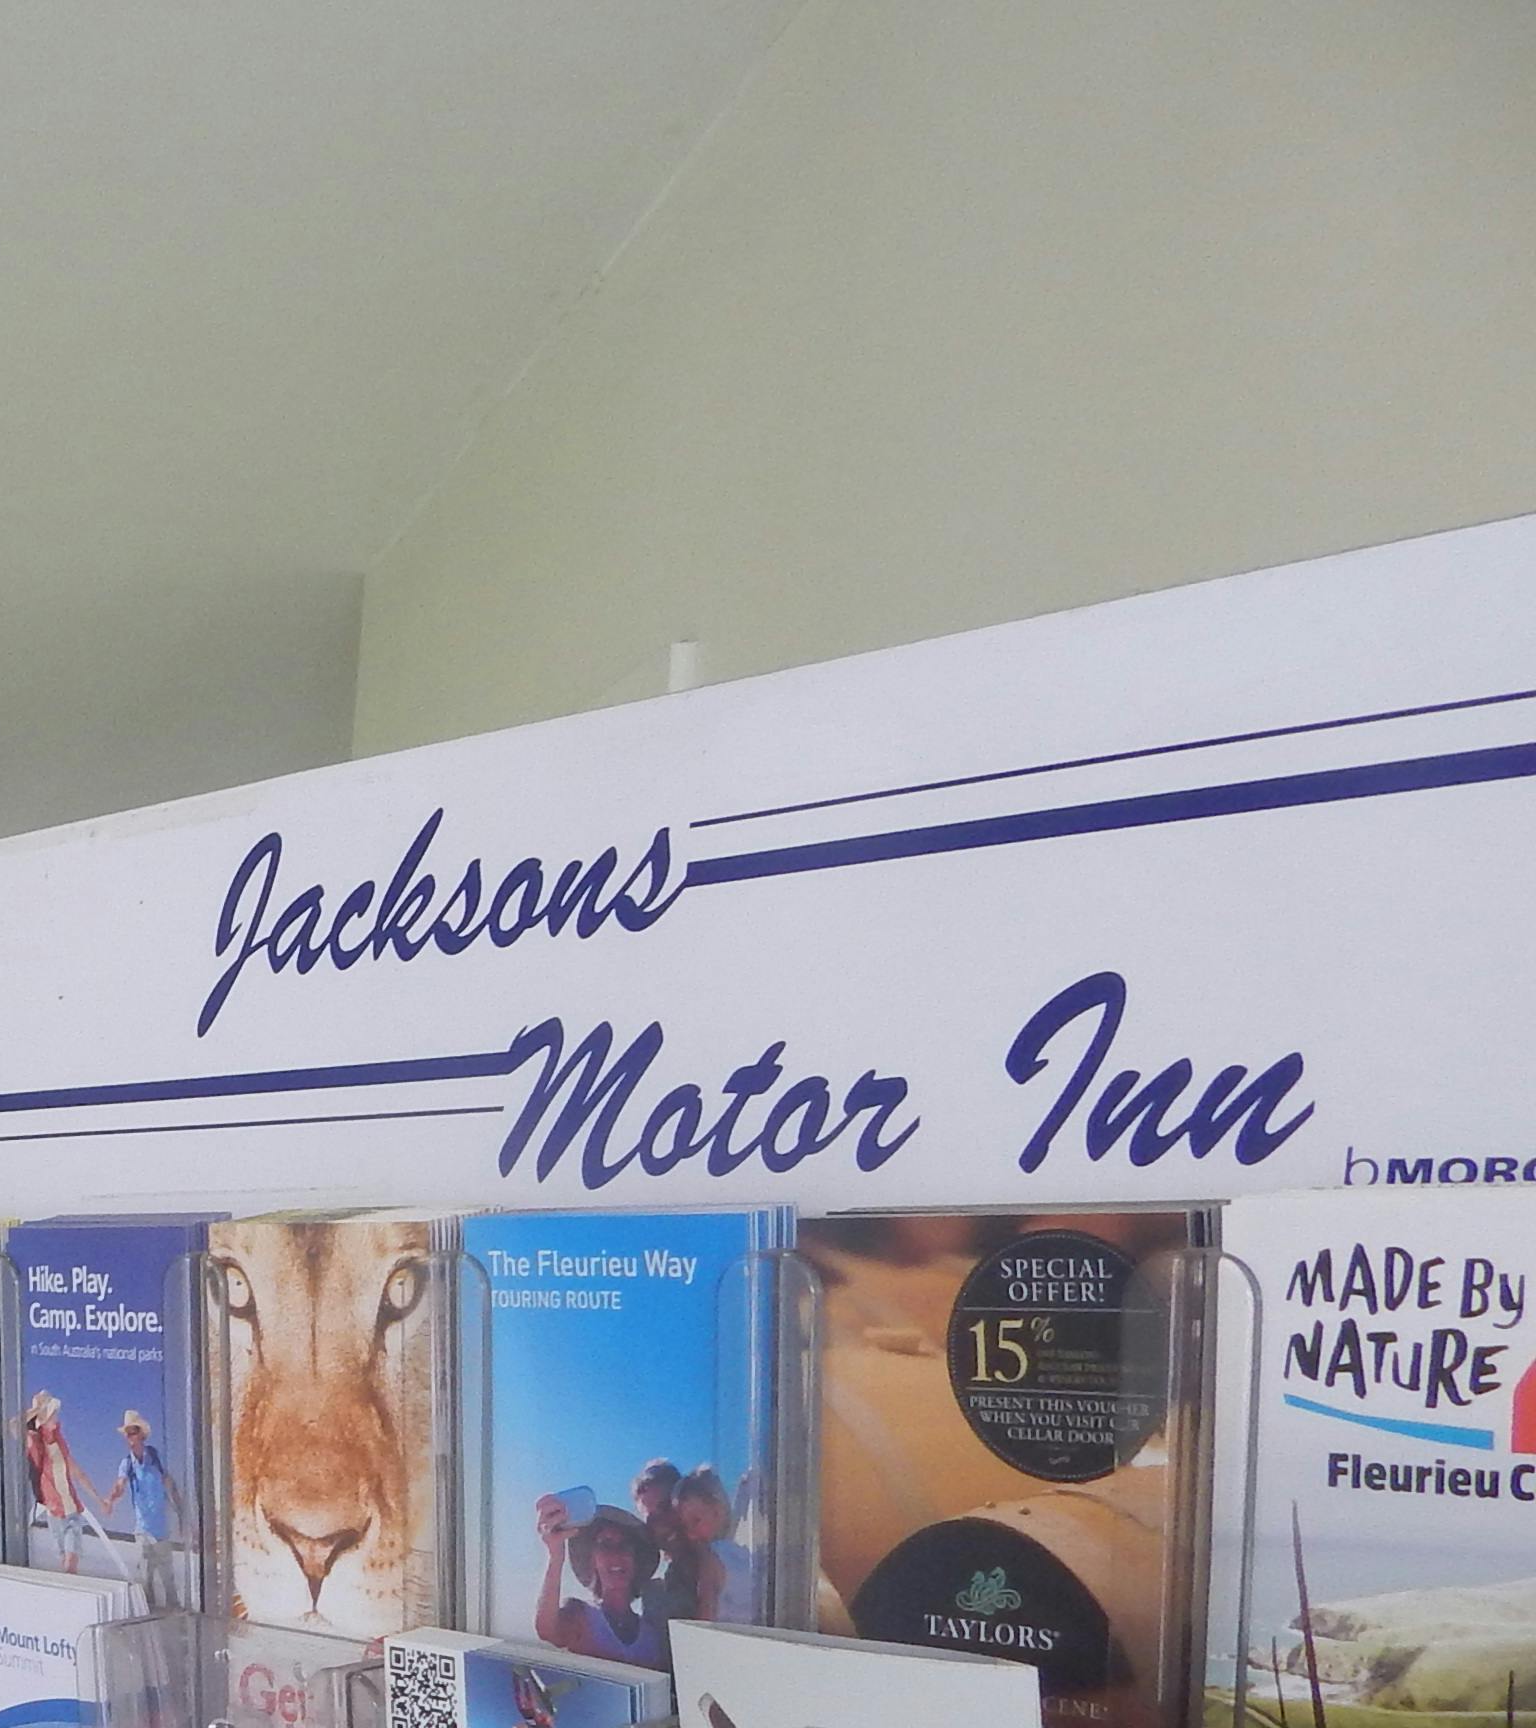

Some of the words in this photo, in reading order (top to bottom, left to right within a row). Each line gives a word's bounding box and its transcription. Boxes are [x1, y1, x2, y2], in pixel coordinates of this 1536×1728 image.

[196, 806, 685, 1038] Jacksons
[498, 1017, 920, 1190] Motor
[1005, 970, 1316, 1174] Inn
[28, 1265, 68, 1293] Hike.
[72, 1265, 112, 1301] Play.
[488, 1250, 529, 1277] The
[538, 1251, 638, 1277] Fleurieu
[644, 1250, 697, 1284] Way
[1000, 1258, 1113, 1279] SPECIAL
[1286, 1242, 1446, 1315] MADE
[491, 1290, 561, 1309] TOURING
[566, 1291, 622, 1311] ROUTE
[1008, 1281, 1104, 1302] OFFER!
[30, 1302, 81, 1336] Camp.
[85, 1303, 162, 1338] Explore.
[39, 1342, 60, 1356] South
[63, 1344, 101, 1360] Australia's
[103, 1348, 136, 1361] national
[138, 1348, 163, 1363] parks
[969, 1396, 1031, 1410] PRESENT
[1039, 1400, 1073, 1412] THIS
[980, 1410, 1027, 1424] WHEN
[1029, 1414, 1062, 1426] YOU
[1066, 1415, 1103, 1429] VISIT
[1007, 1427, 1063, 1442] CELLAR
[1067, 1430, 1114, 1444] DOOR
[1328, 1453, 1500, 1498] Fleurieu
[924, 1613, 1054, 1651] TAYLORS
